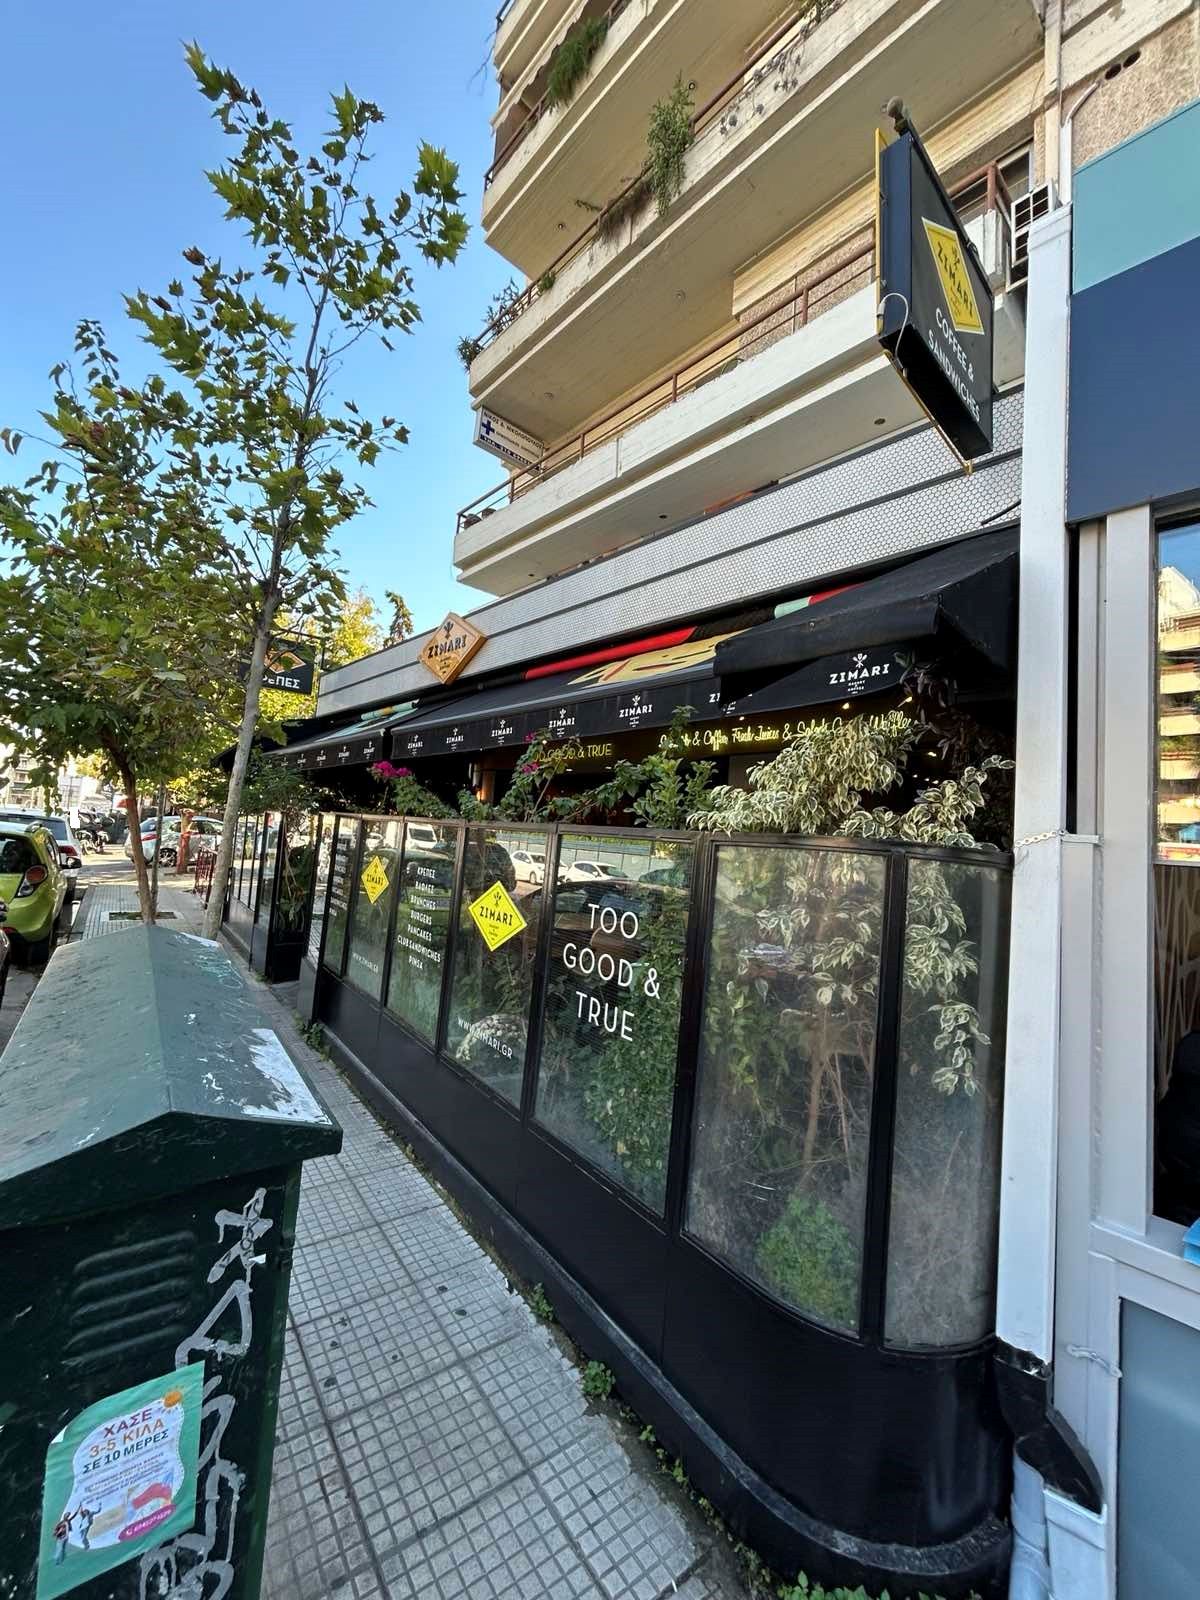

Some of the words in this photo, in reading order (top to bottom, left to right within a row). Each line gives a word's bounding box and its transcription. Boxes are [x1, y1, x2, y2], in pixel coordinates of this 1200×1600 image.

[938, 241, 973, 319] ZIMARI
[935, 307, 968, 371] COFFEE
[967, 362, 974, 383] &
[928, 329, 980, 422] SANDWICHES
[428, 634, 467, 659] ZIMARI
[829, 663, 890, 685] ZIMARI
[619, 704, 653, 718] ZIMARI
[491, 727, 513, 737] ZIMARI
[549, 718, 575, 728] ZIMARI
[407, 741, 423, 749] ZIMARI
[446, 735, 464, 744] ZIMARI
[692, 730, 701, 746] &
[782, 723, 791, 740] &
[587, 743, 612, 757] TRUE
[410, 910, 432, 925] BURGERS
[480, 906, 513, 926] ZIMARI
[588, 903, 639, 939] TOO
[408, 924, 432, 941] PANCAKES
[409, 940, 441, 962] SANDWICHES
[563, 943, 633, 987] GOOD
[644, 967, 660, 999] &
[575, 991, 635, 1041] TRUE
[103, 1408, 152, 1438] ΧΑΣΕ
[90, 1438, 116, 1458] 3-5
[123, 1419, 164, 1445] ΚΙΛΑ
[83, 1458, 102, 1474] ΣΕ
[104, 1449, 121, 1465] 10
[123, 1429, 169, 1456] ΜΕΡΕΣ
